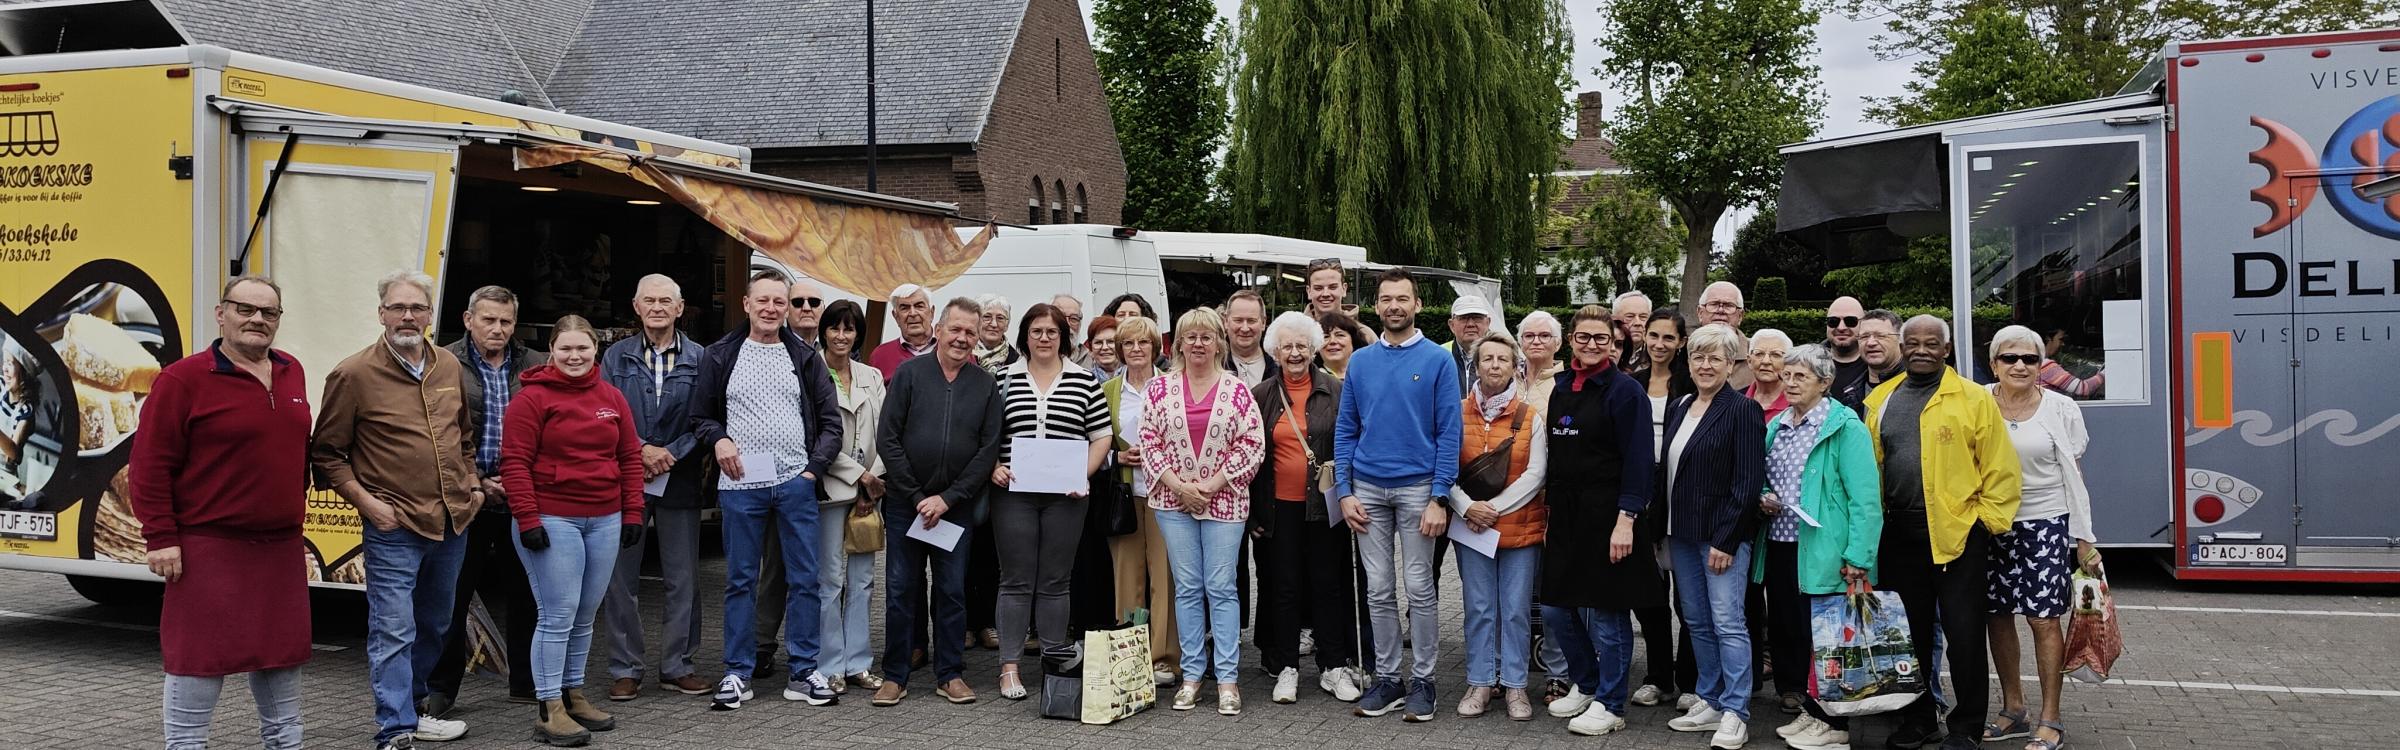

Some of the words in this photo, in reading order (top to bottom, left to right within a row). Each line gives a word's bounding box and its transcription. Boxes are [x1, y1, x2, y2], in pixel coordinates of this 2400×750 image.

[2310, 67, 2398, 90] VISVE
[15, 193, 22, 203] is
[23, 194, 38, 202] voor
[40, 192, 49, 203] bij
[51, 192, 60, 201] de
[61, 192, 83, 203] koffie
[2233, 326, 2390, 343] VISDELI
